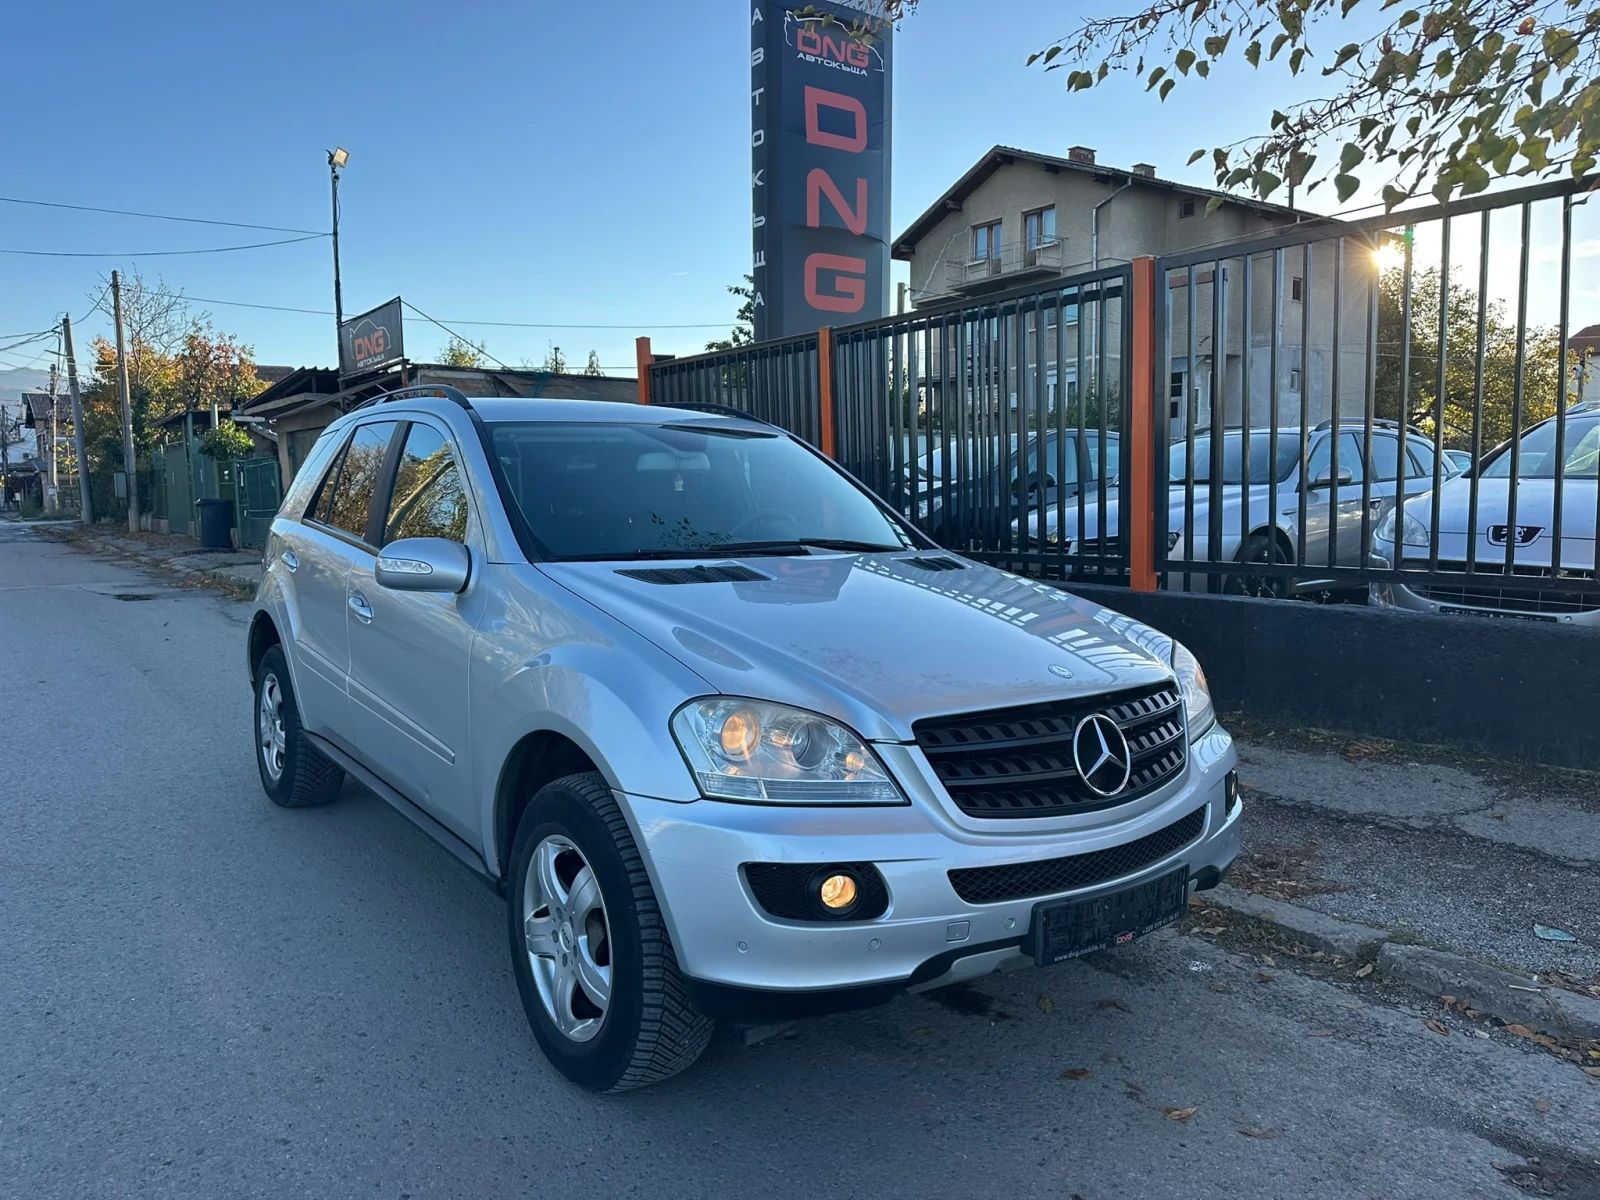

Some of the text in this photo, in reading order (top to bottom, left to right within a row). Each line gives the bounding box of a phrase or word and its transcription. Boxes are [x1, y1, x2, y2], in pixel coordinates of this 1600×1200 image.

[797, 28, 869, 68] DNG
[797, 52, 868, 77] АВТОКЪША
[751, 7, 766, 307] АВТОКЪША
[804, 85, 867, 313] DNG
[354, 330, 384, 360] DNG
